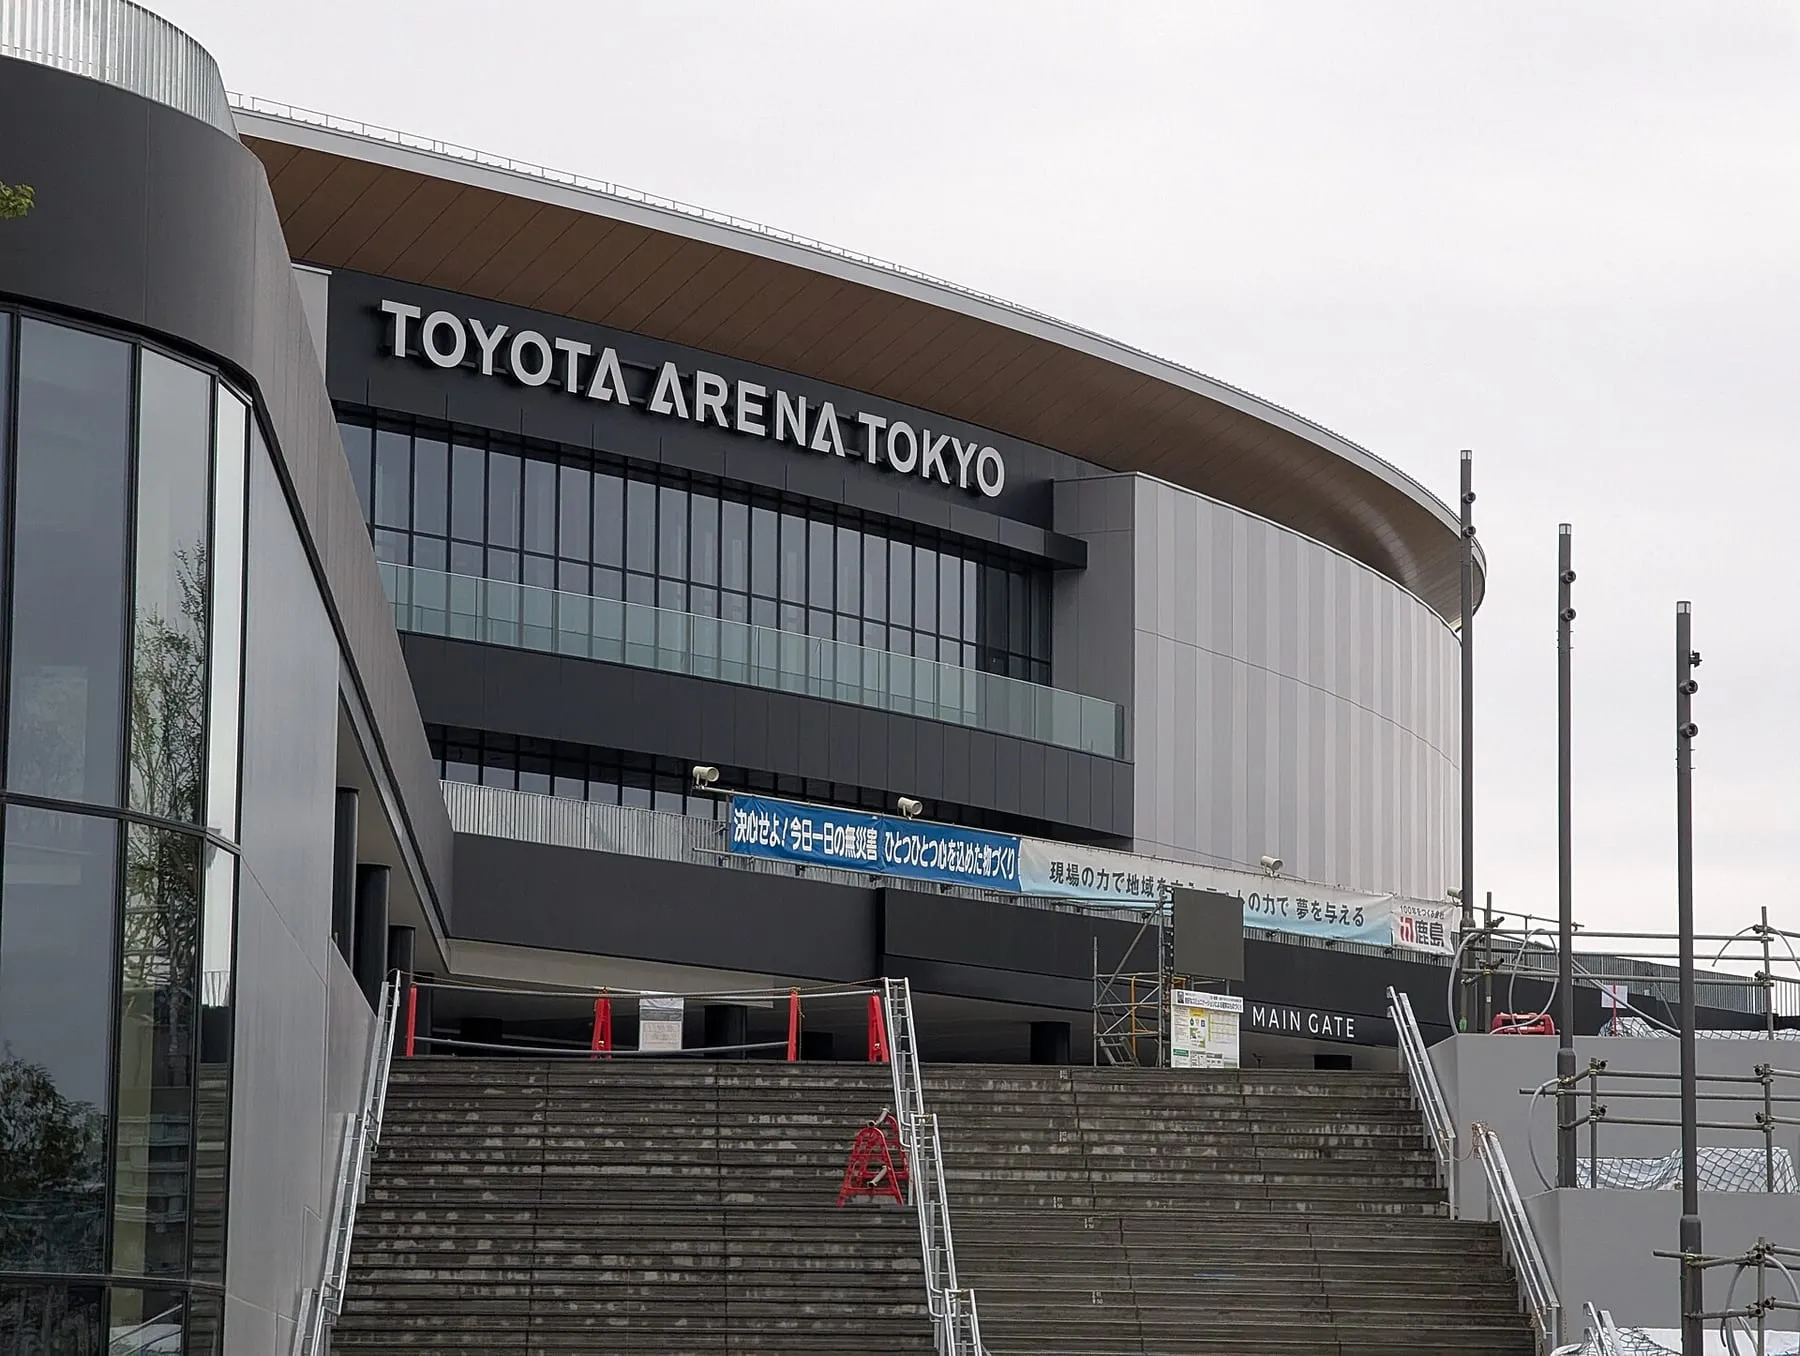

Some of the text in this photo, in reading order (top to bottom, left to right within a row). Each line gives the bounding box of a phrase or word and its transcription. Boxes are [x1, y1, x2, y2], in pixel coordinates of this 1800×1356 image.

[380, 299, 1006, 498] TOYOTA ARENA TOKYO
[885, 831, 1015, 880] ひとつひとつ心を込めた物づくり
[1415, 920, 1444, 947] 鹿島
[1252, 1006, 1301, 1031] MAIN
[1308, 1013, 1356, 1038] GATE
